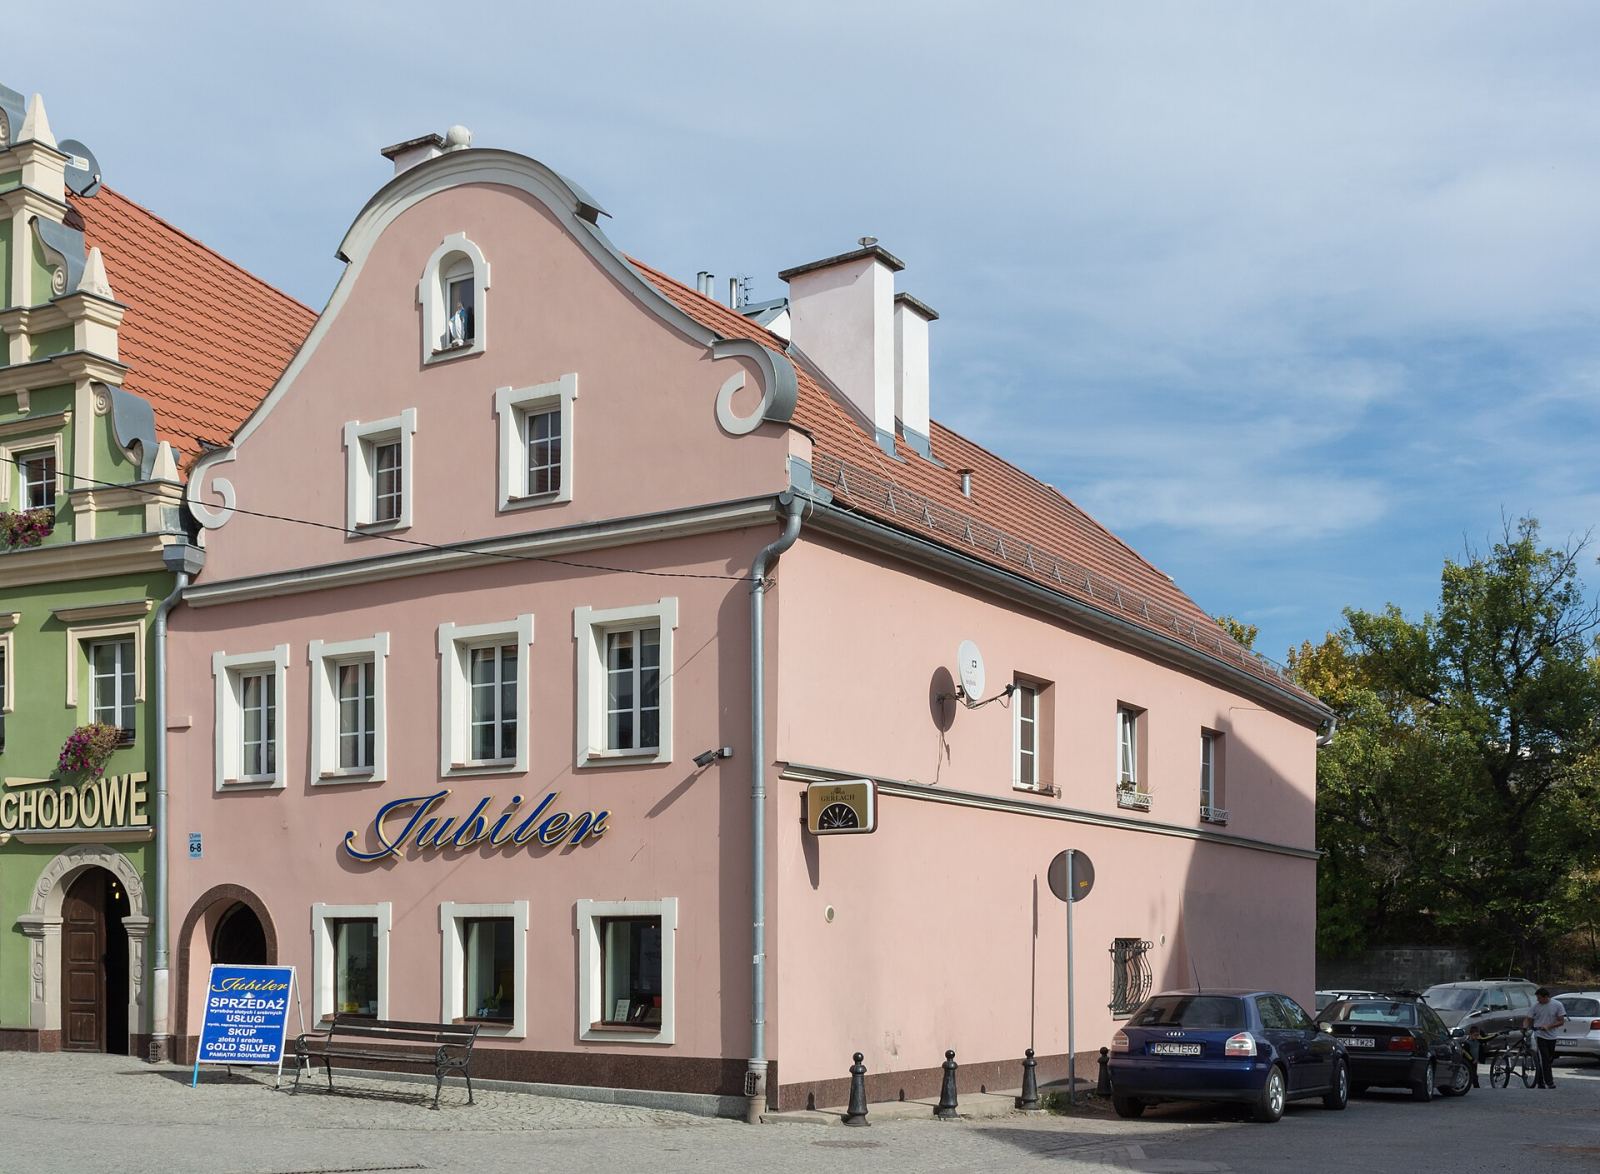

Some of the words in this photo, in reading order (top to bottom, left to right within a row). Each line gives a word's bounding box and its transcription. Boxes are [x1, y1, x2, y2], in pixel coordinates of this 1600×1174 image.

[0, 772, 148, 829] CHODOWE
[344, 789, 612, 861] Jubiler
[190, 843, 201, 852] 6-8
[211, 977, 288, 992] Jubiler
[210, 998, 285, 1010] SPRZEDAŻ
[226, 1014, 265, 1023] USŁUGI
[228, 1028, 256, 1036] SKUP
[206, 1043, 236, 1051] GOLD
[239, 1044, 276, 1052] SILVER
